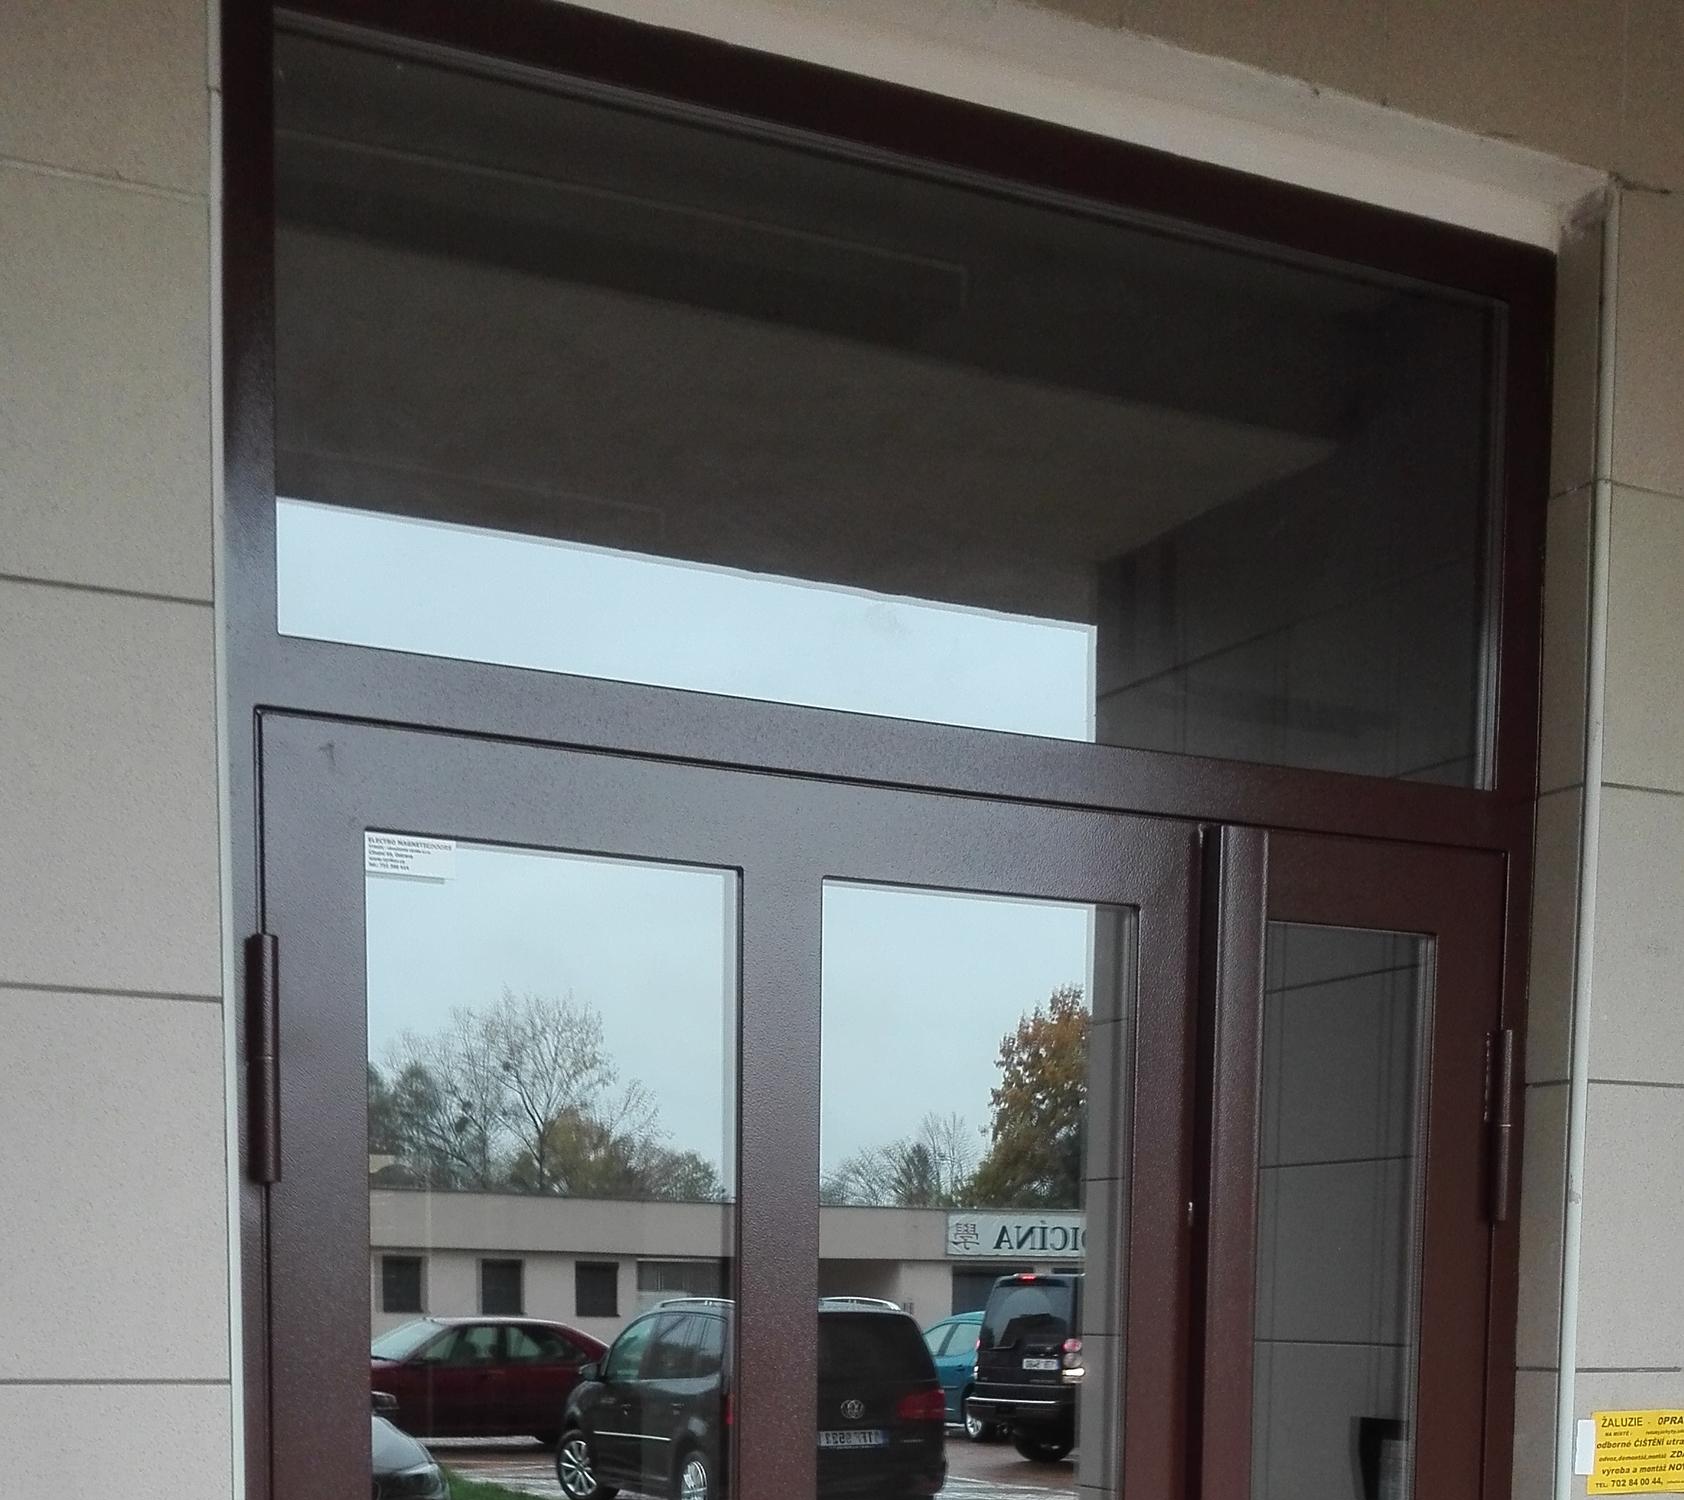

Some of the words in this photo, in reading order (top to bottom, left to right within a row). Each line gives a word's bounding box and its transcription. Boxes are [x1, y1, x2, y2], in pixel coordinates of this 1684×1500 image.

[1601, 1416, 1643, 1427] ŽALUZIE
[1601, 1467, 1631, 1477] výroba
[1611, 1479, 1627, 1487] 702
[1629, 1478, 1638, 1486] 84
[1640, 1478, 1650, 1486] 00
